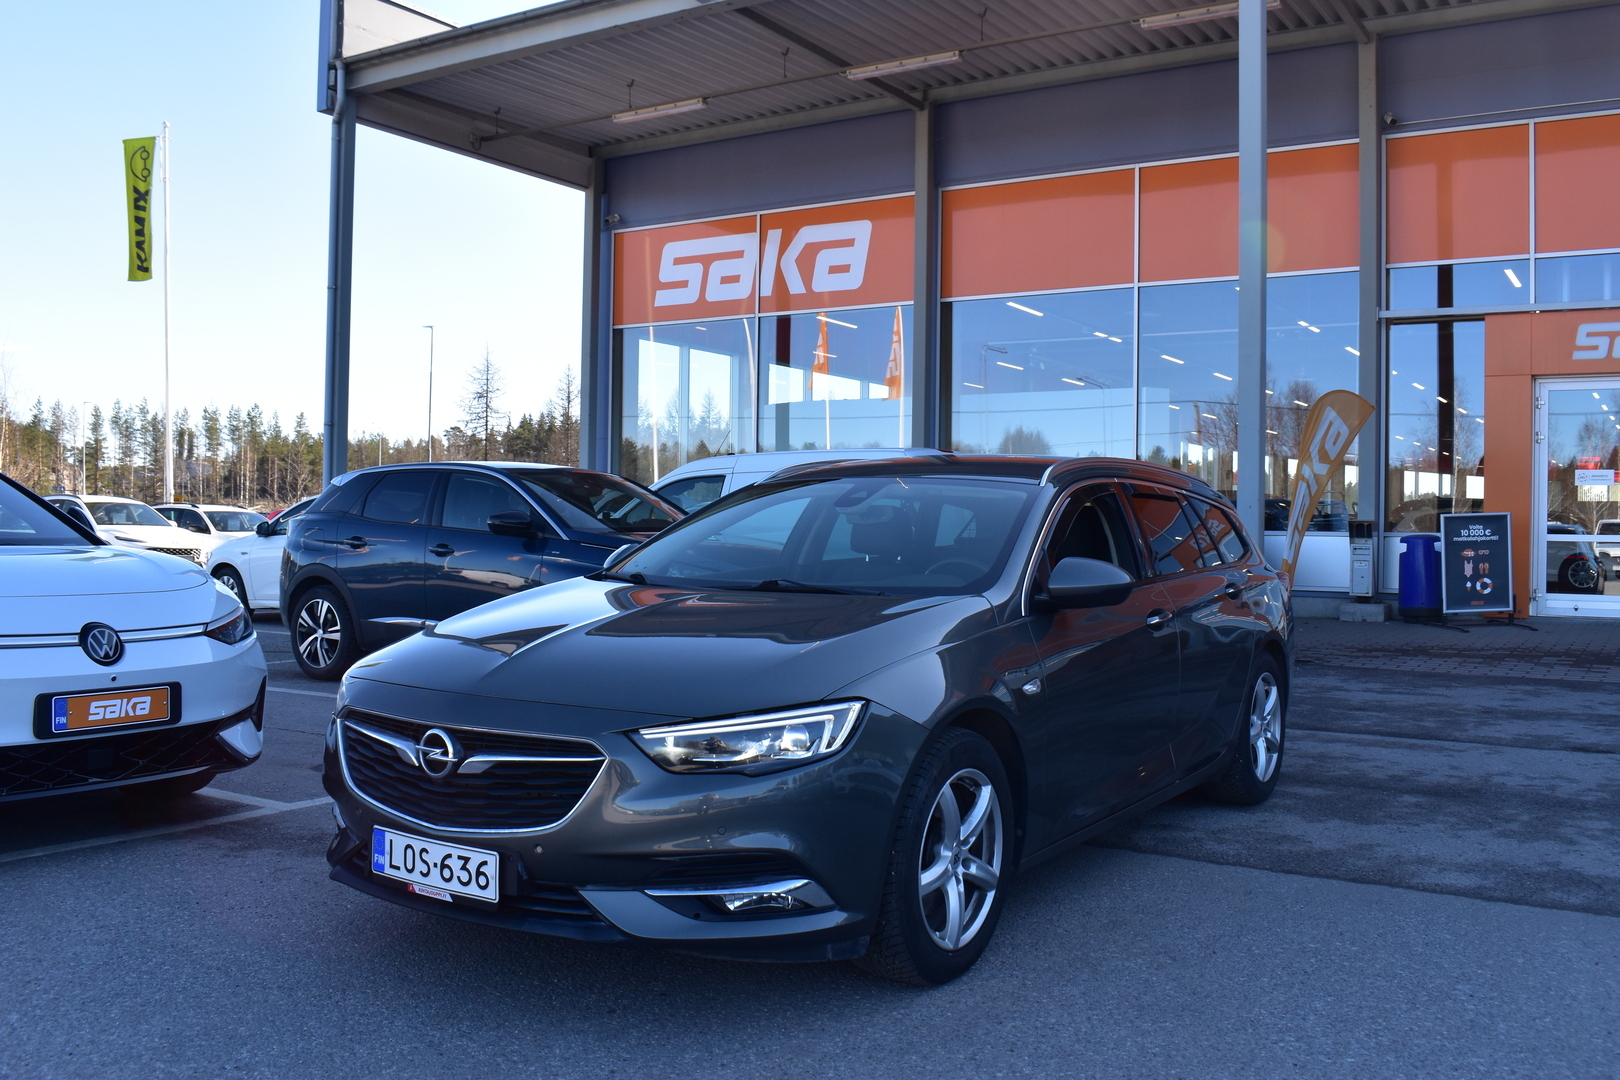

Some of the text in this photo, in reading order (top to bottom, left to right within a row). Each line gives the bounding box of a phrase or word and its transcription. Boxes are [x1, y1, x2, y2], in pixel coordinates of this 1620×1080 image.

[133, 185, 149, 273] KAMIX
[56, 716, 66, 724] FIN
[374, 853, 385, 865] FIN
[389, 838, 490, 891] LOS-636
